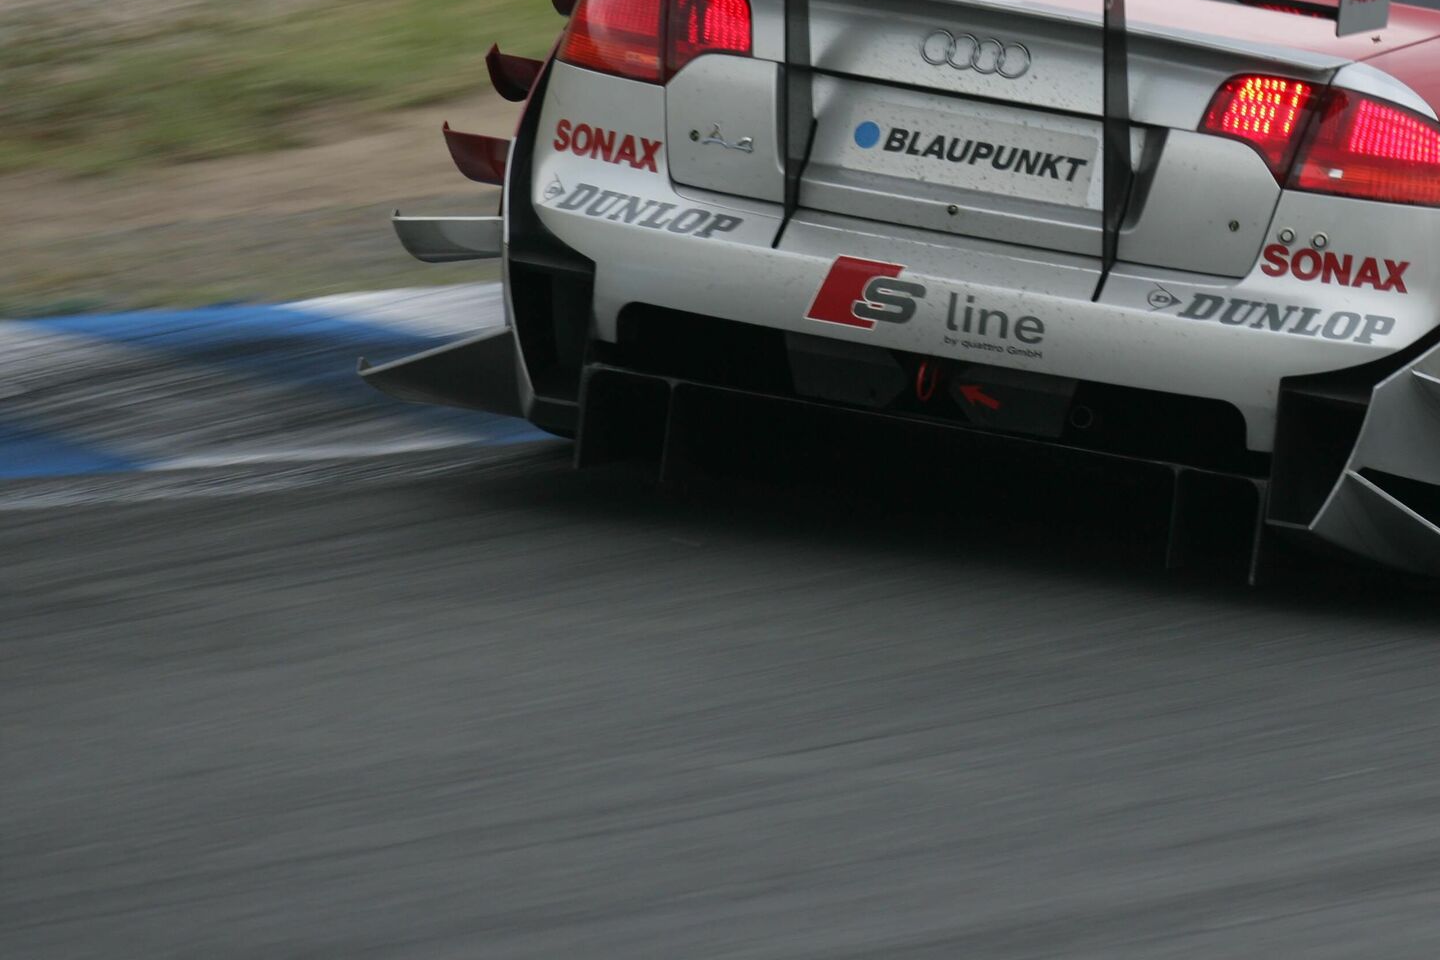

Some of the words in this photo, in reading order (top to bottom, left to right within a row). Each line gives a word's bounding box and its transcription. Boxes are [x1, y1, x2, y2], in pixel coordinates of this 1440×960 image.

[552, 118, 663, 174] SONAX
[883, 126, 1088, 183] BLAUPUNKT
[555, 182, 745, 239] DUNLOP
[1260, 243, 1411, 294] SONAX
[945, 291, 1046, 345] line
[1176, 292, 1396, 346] DUNLOP
[960, 340, 1004, 353] quattro
[1005, 345, 1044, 359] GmbH
